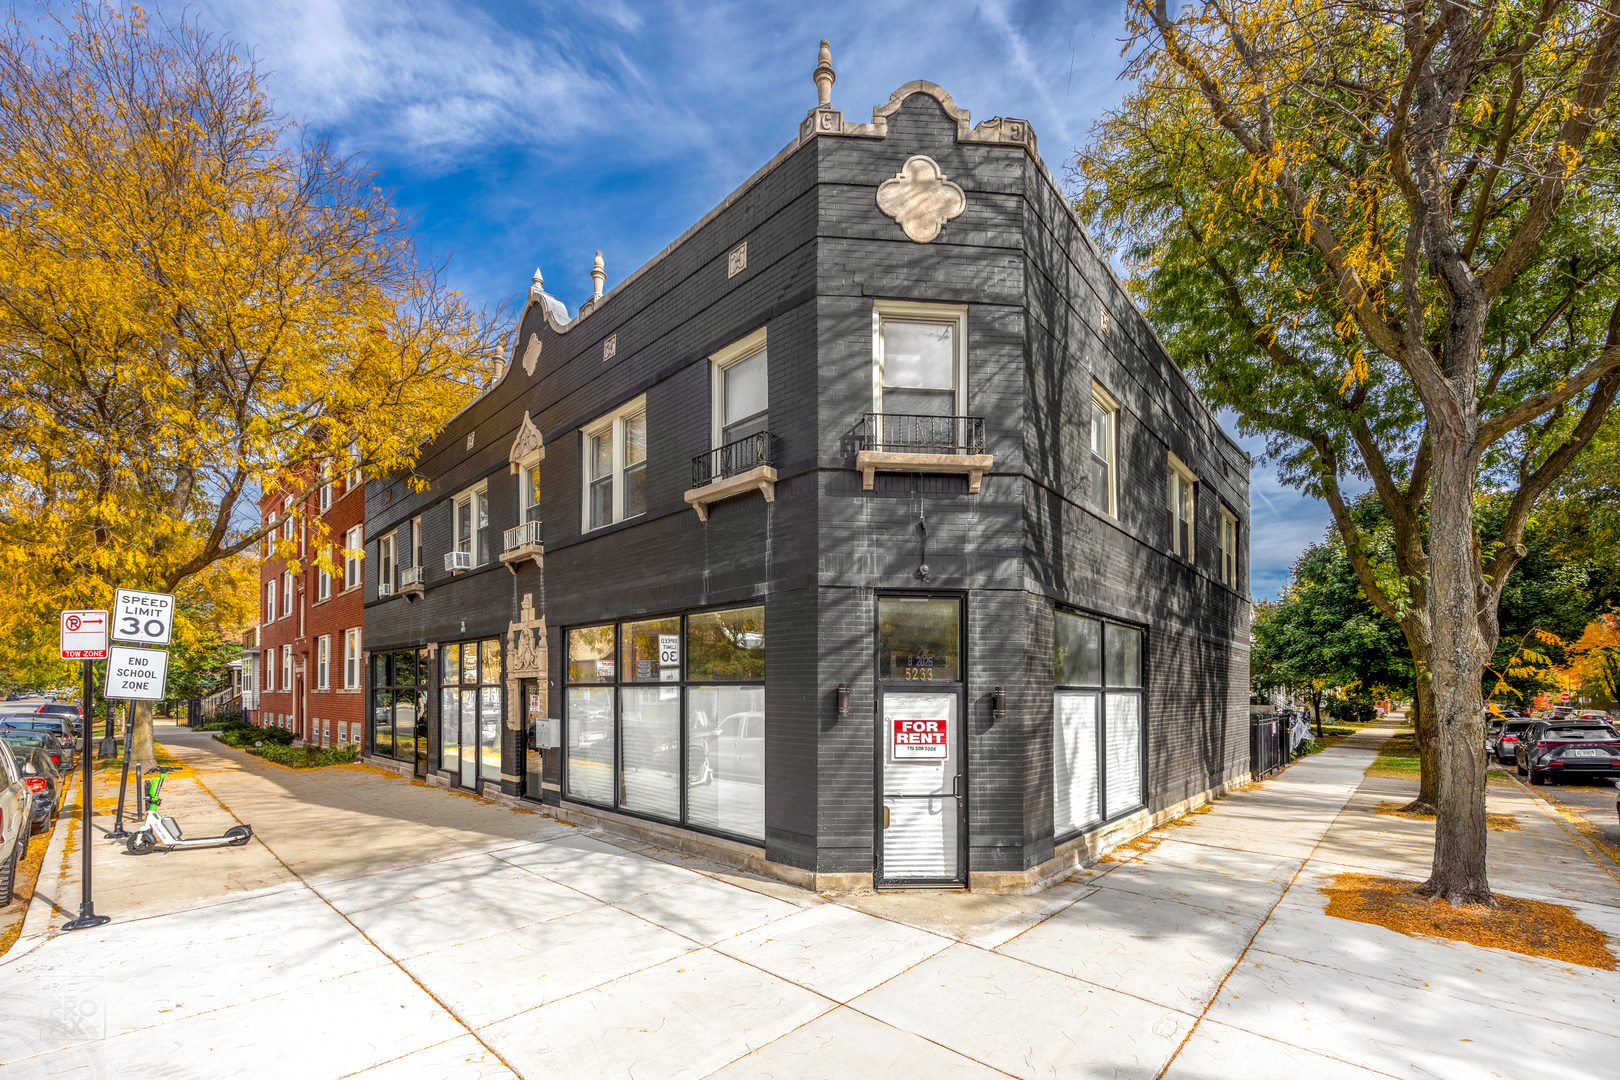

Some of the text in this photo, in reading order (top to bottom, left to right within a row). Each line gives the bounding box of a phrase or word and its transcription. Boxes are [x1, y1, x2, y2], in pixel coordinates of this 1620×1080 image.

[122, 595, 168, 608] SPEED
[125, 606, 163, 617] LIMIT
[119, 617, 165, 637] 30
[128, 657, 149, 666] END
[916, 656, 934, 667] 2026
[116, 668, 157, 679] SCHOOL
[905, 667, 933, 680] 5233
[121, 681, 150, 690] ZONE
[902, 721, 938, 732] FOR
[896, 733, 945, 743] RENT
